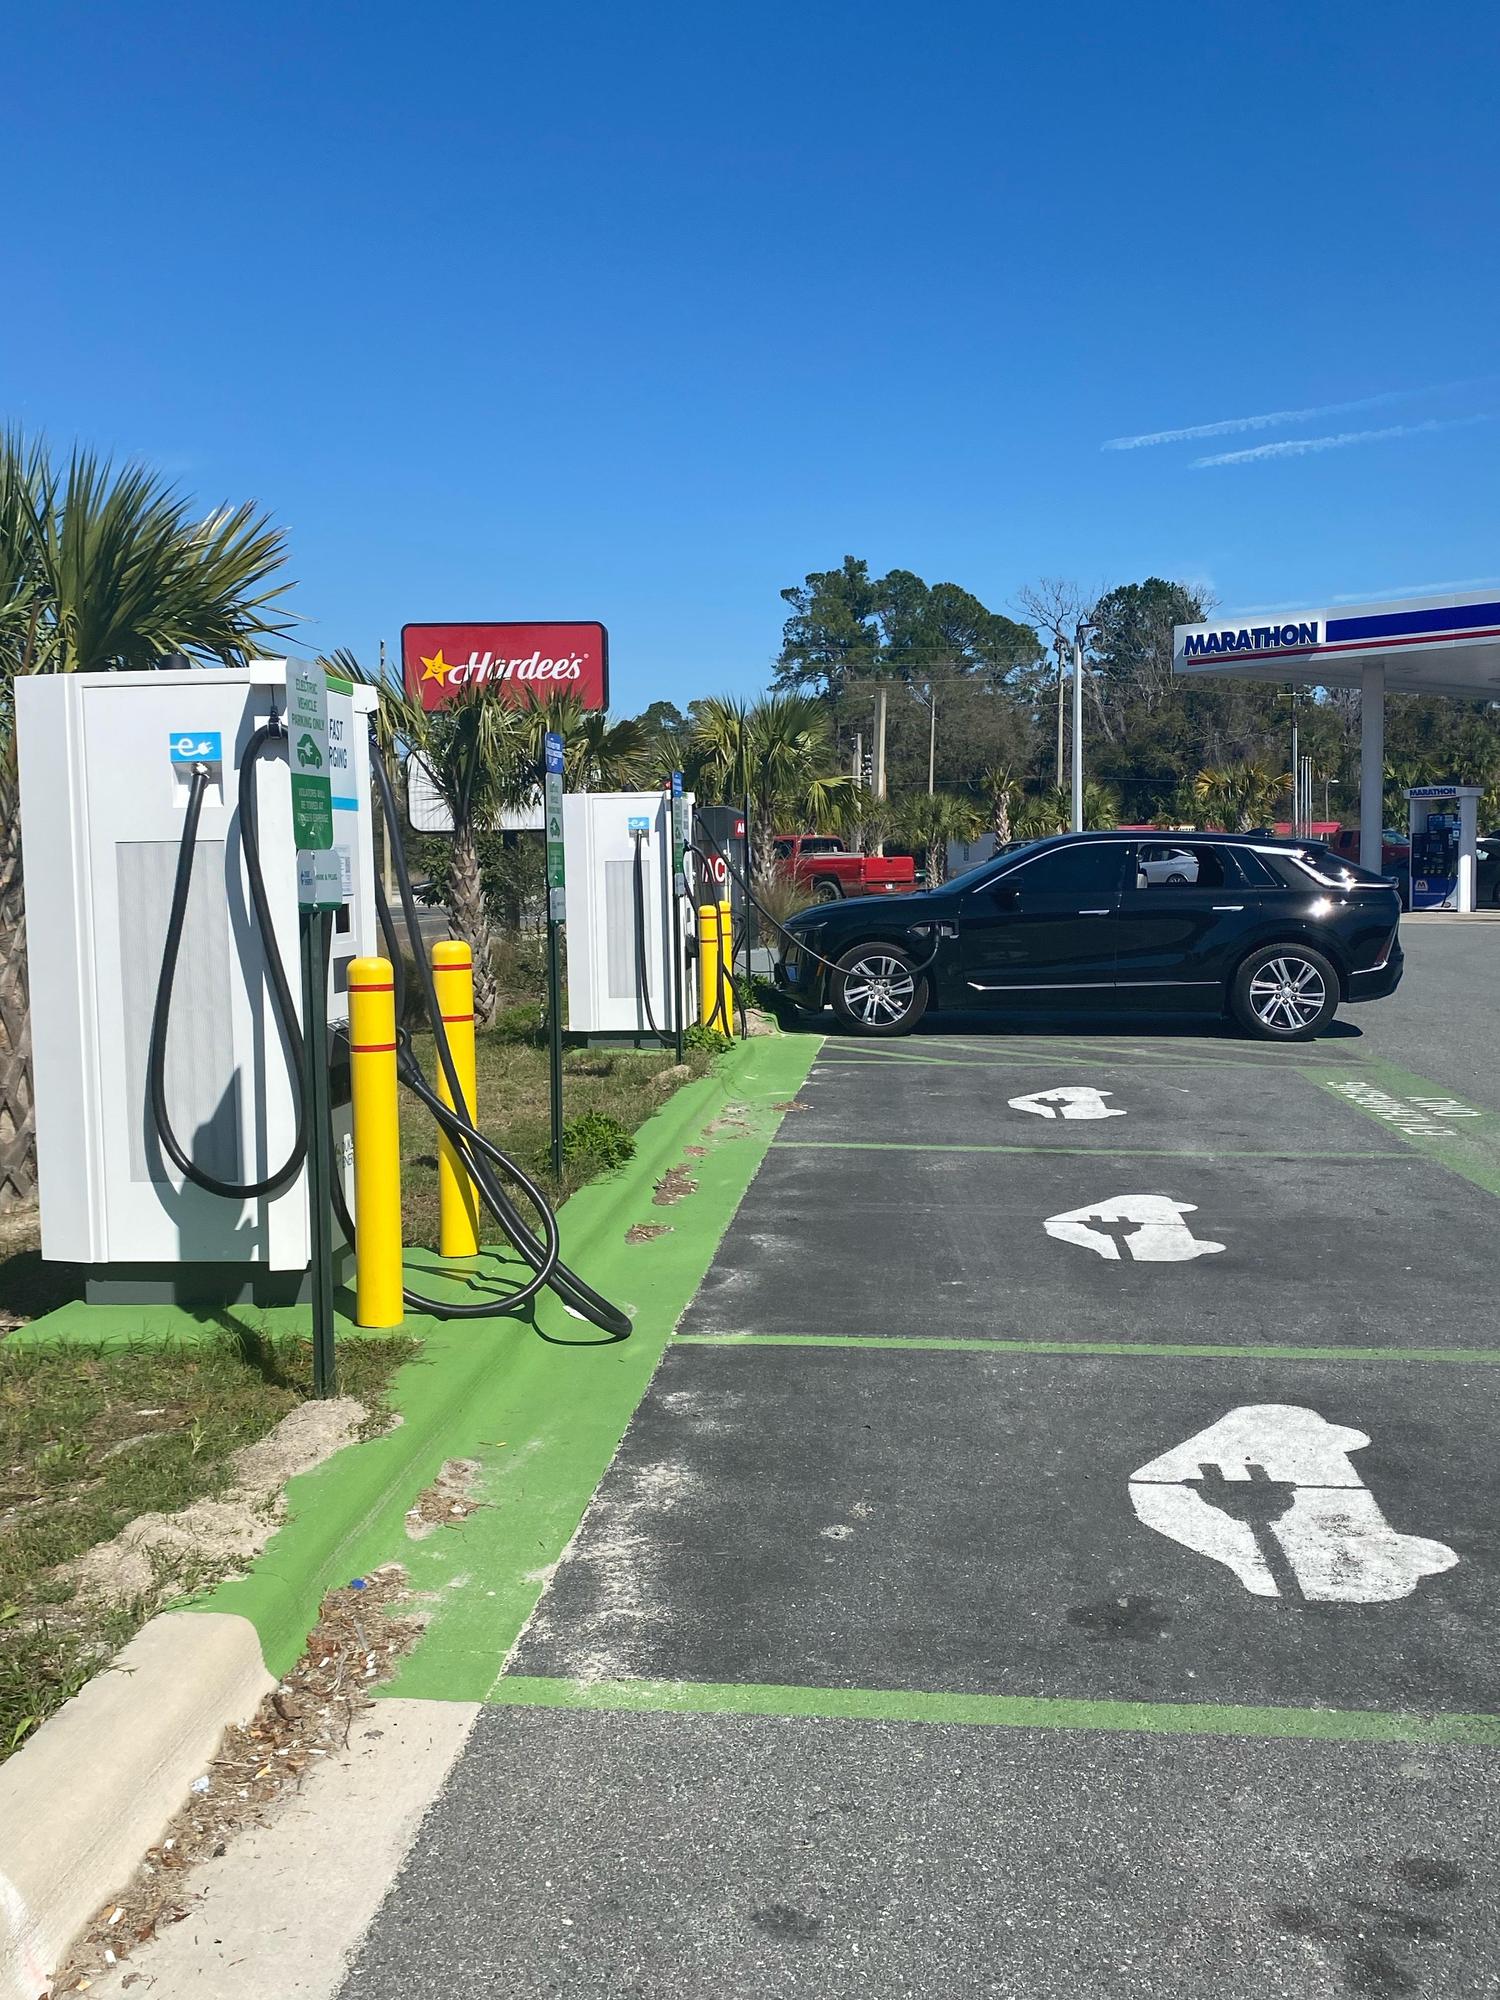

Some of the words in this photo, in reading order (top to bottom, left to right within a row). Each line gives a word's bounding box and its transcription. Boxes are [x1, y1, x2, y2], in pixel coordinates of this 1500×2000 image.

[1184, 621, 1319, 657] MARATHON
[447, 650, 583, 685] Hardee's
[295, 678, 318, 695] ELECTRIC
[297, 696, 318, 712] VEHICLE
[291, 712, 312, 729] PARKING
[312, 718, 325, 731] ONLY
[329, 718, 344, 741] FAST
[1409, 787, 1457, 796] MARATHON
